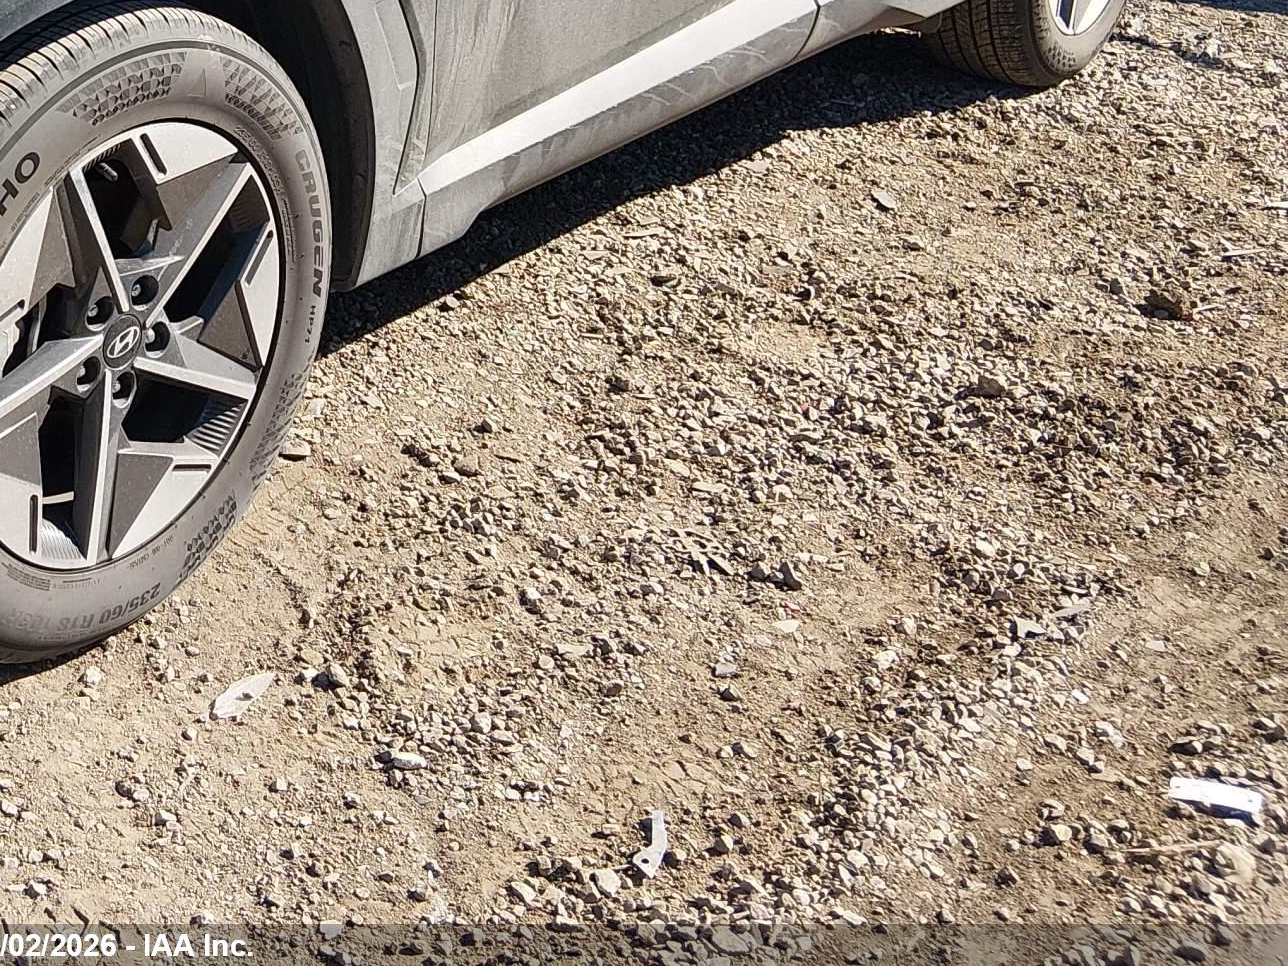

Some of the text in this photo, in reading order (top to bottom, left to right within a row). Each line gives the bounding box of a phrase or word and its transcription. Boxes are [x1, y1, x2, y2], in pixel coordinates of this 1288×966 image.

[295, 149, 324, 344] CRUGEN HP71
[57, 611, 95, 630] R18
[99, 581, 162, 624] 235/60
